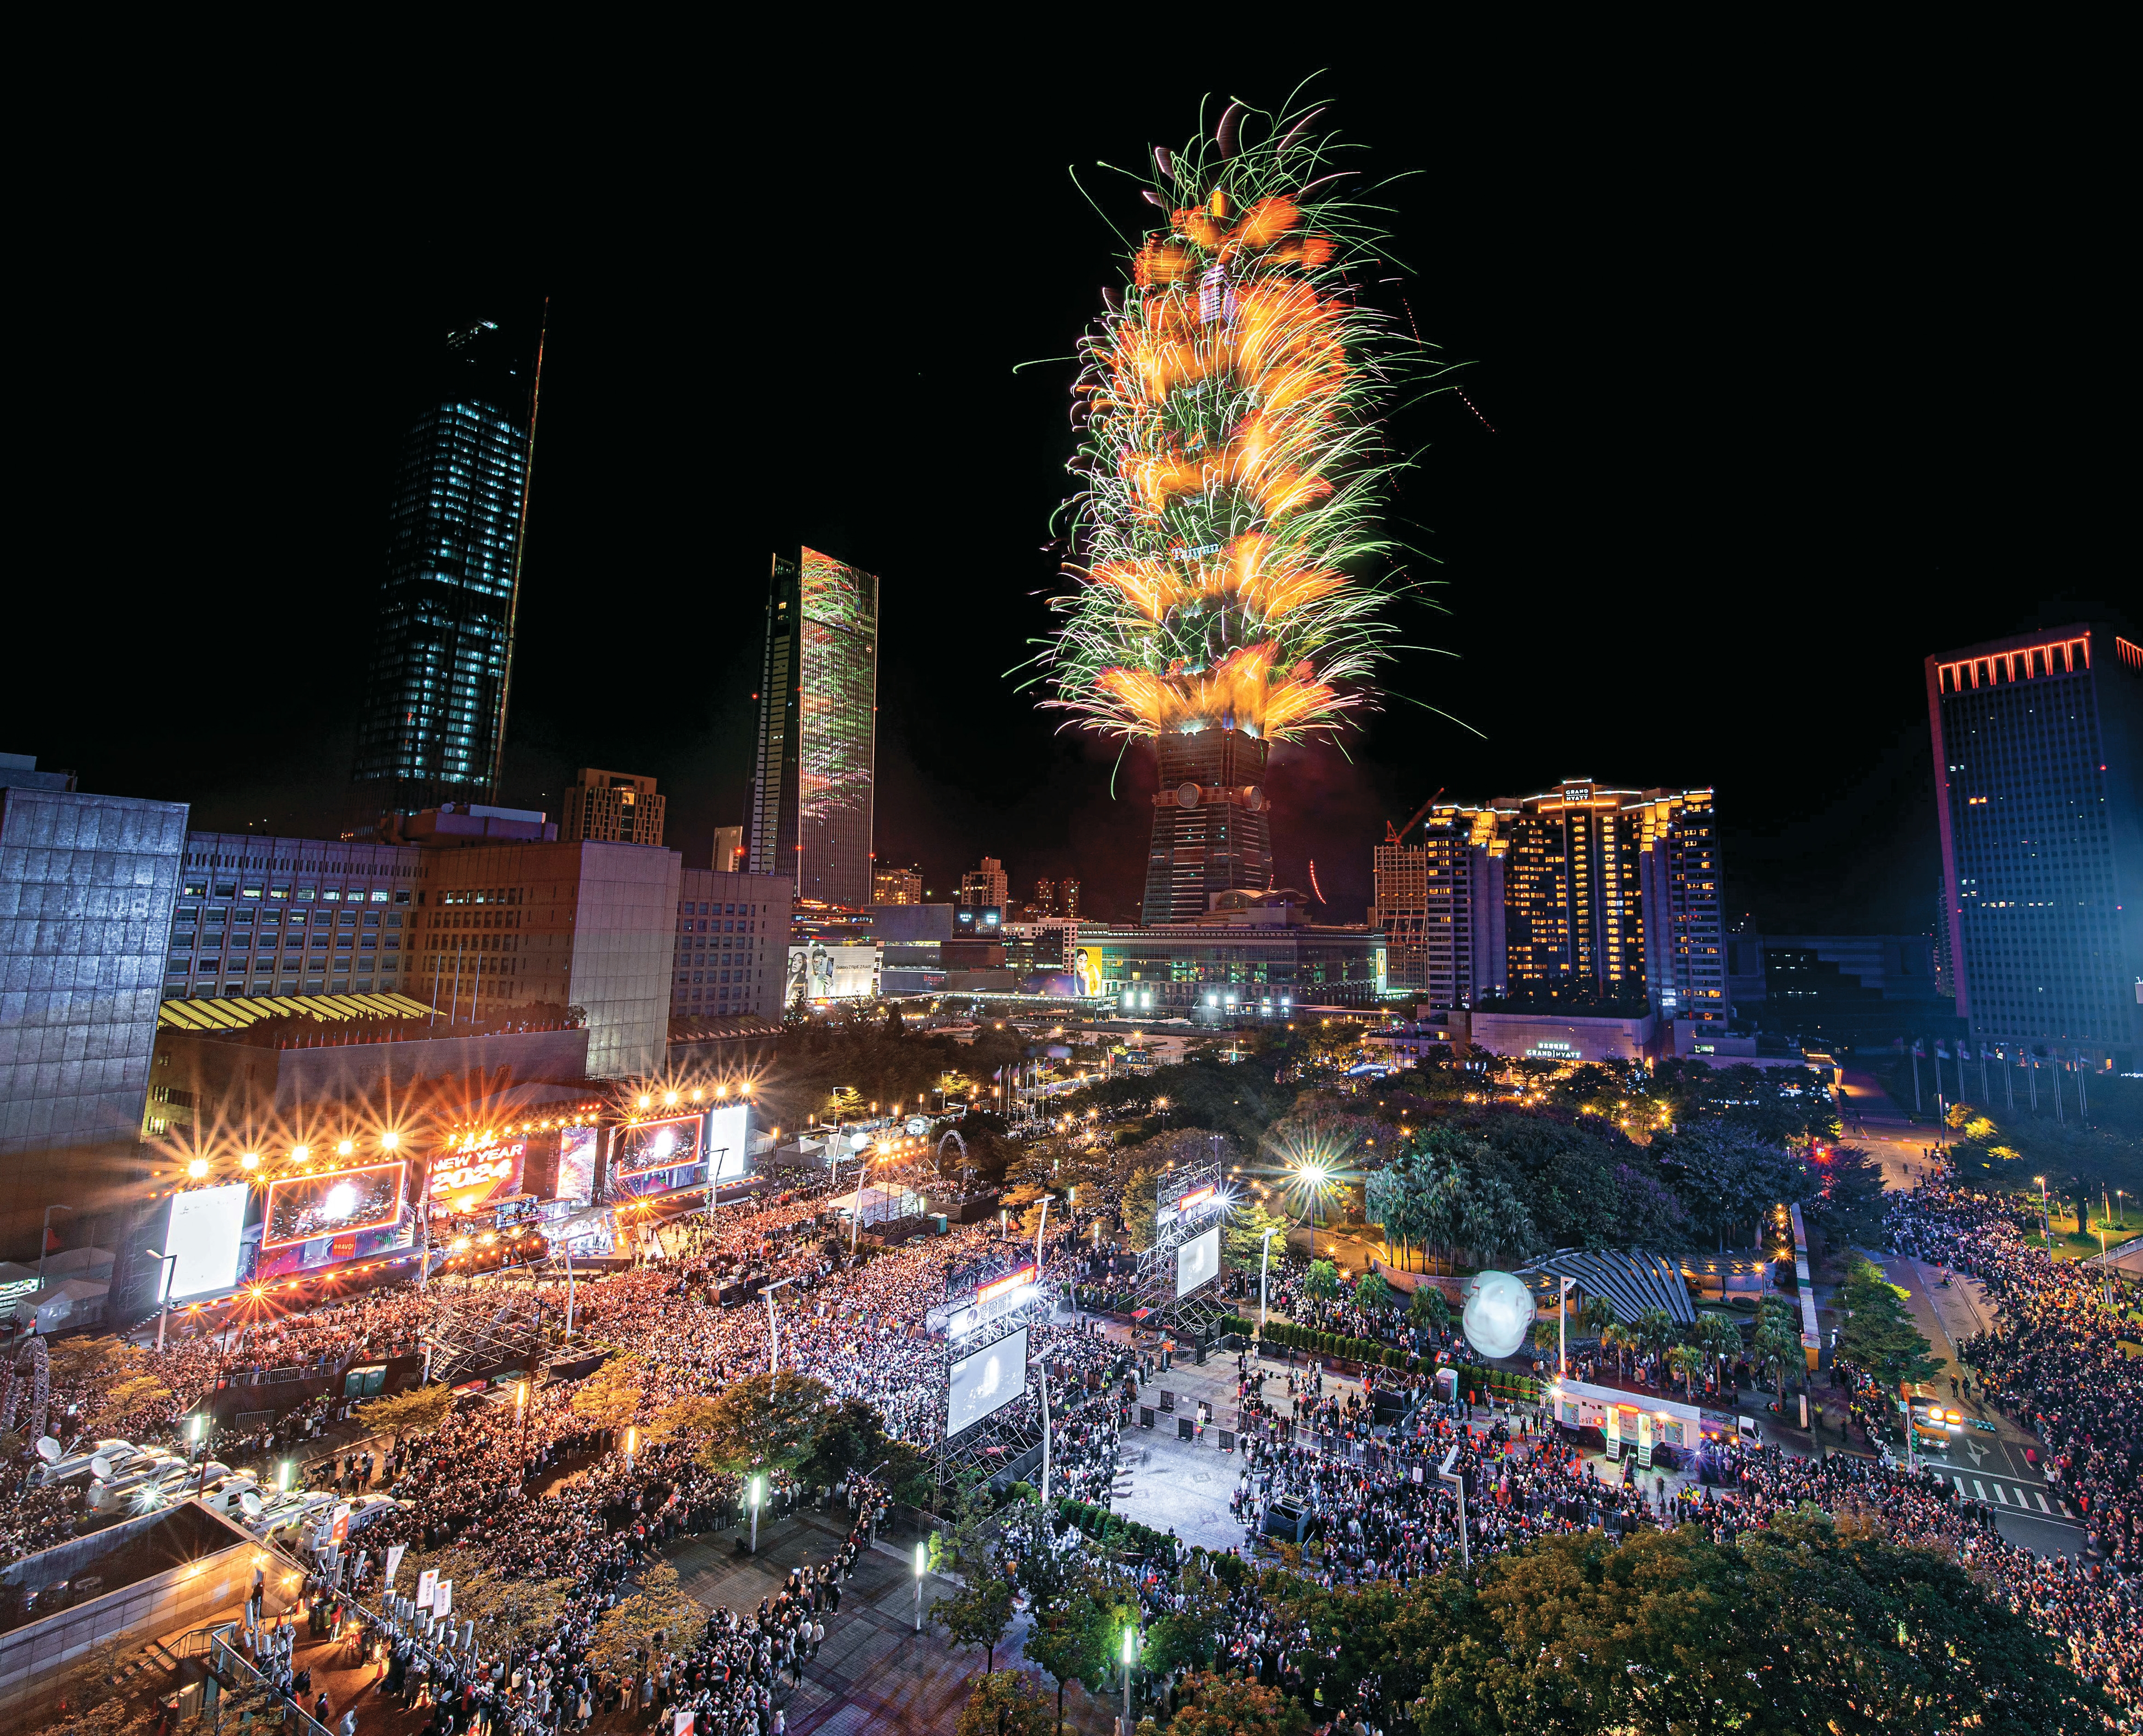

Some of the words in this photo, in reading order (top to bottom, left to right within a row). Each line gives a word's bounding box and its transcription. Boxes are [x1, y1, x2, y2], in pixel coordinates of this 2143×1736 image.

[1171, 543, 1219, 561] Taiwan
[427, 1154, 472, 1174] NEW
[476, 1144, 524, 1163] YEAR
[430, 1158, 513, 1195] 2024
[978, 1296, 1007, 1324] 愛爾麗
